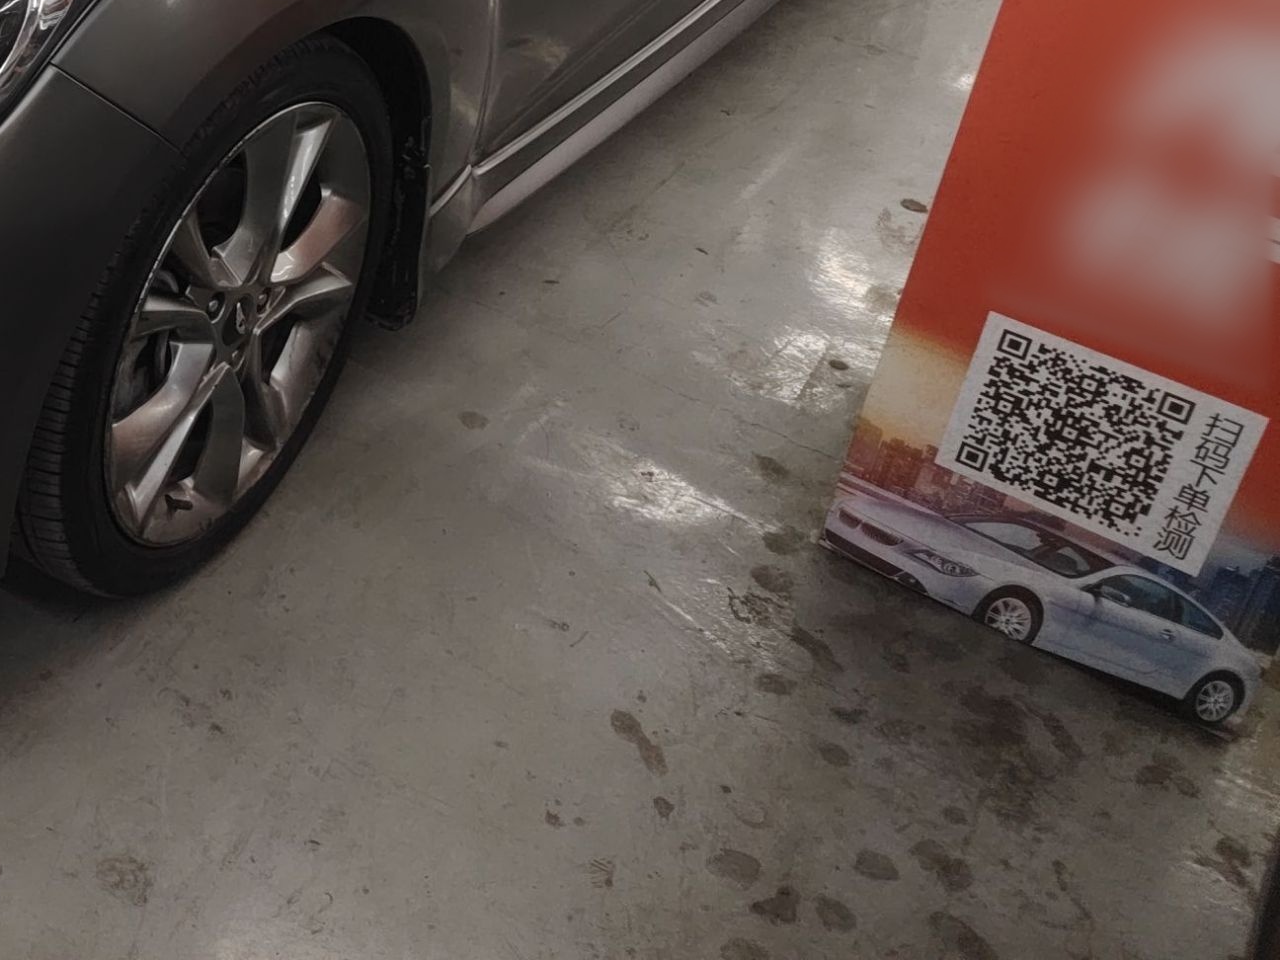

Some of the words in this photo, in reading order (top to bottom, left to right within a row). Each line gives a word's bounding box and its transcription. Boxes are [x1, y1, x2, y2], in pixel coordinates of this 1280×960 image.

[1153, 413, 1245, 561] 扫码下单检测
